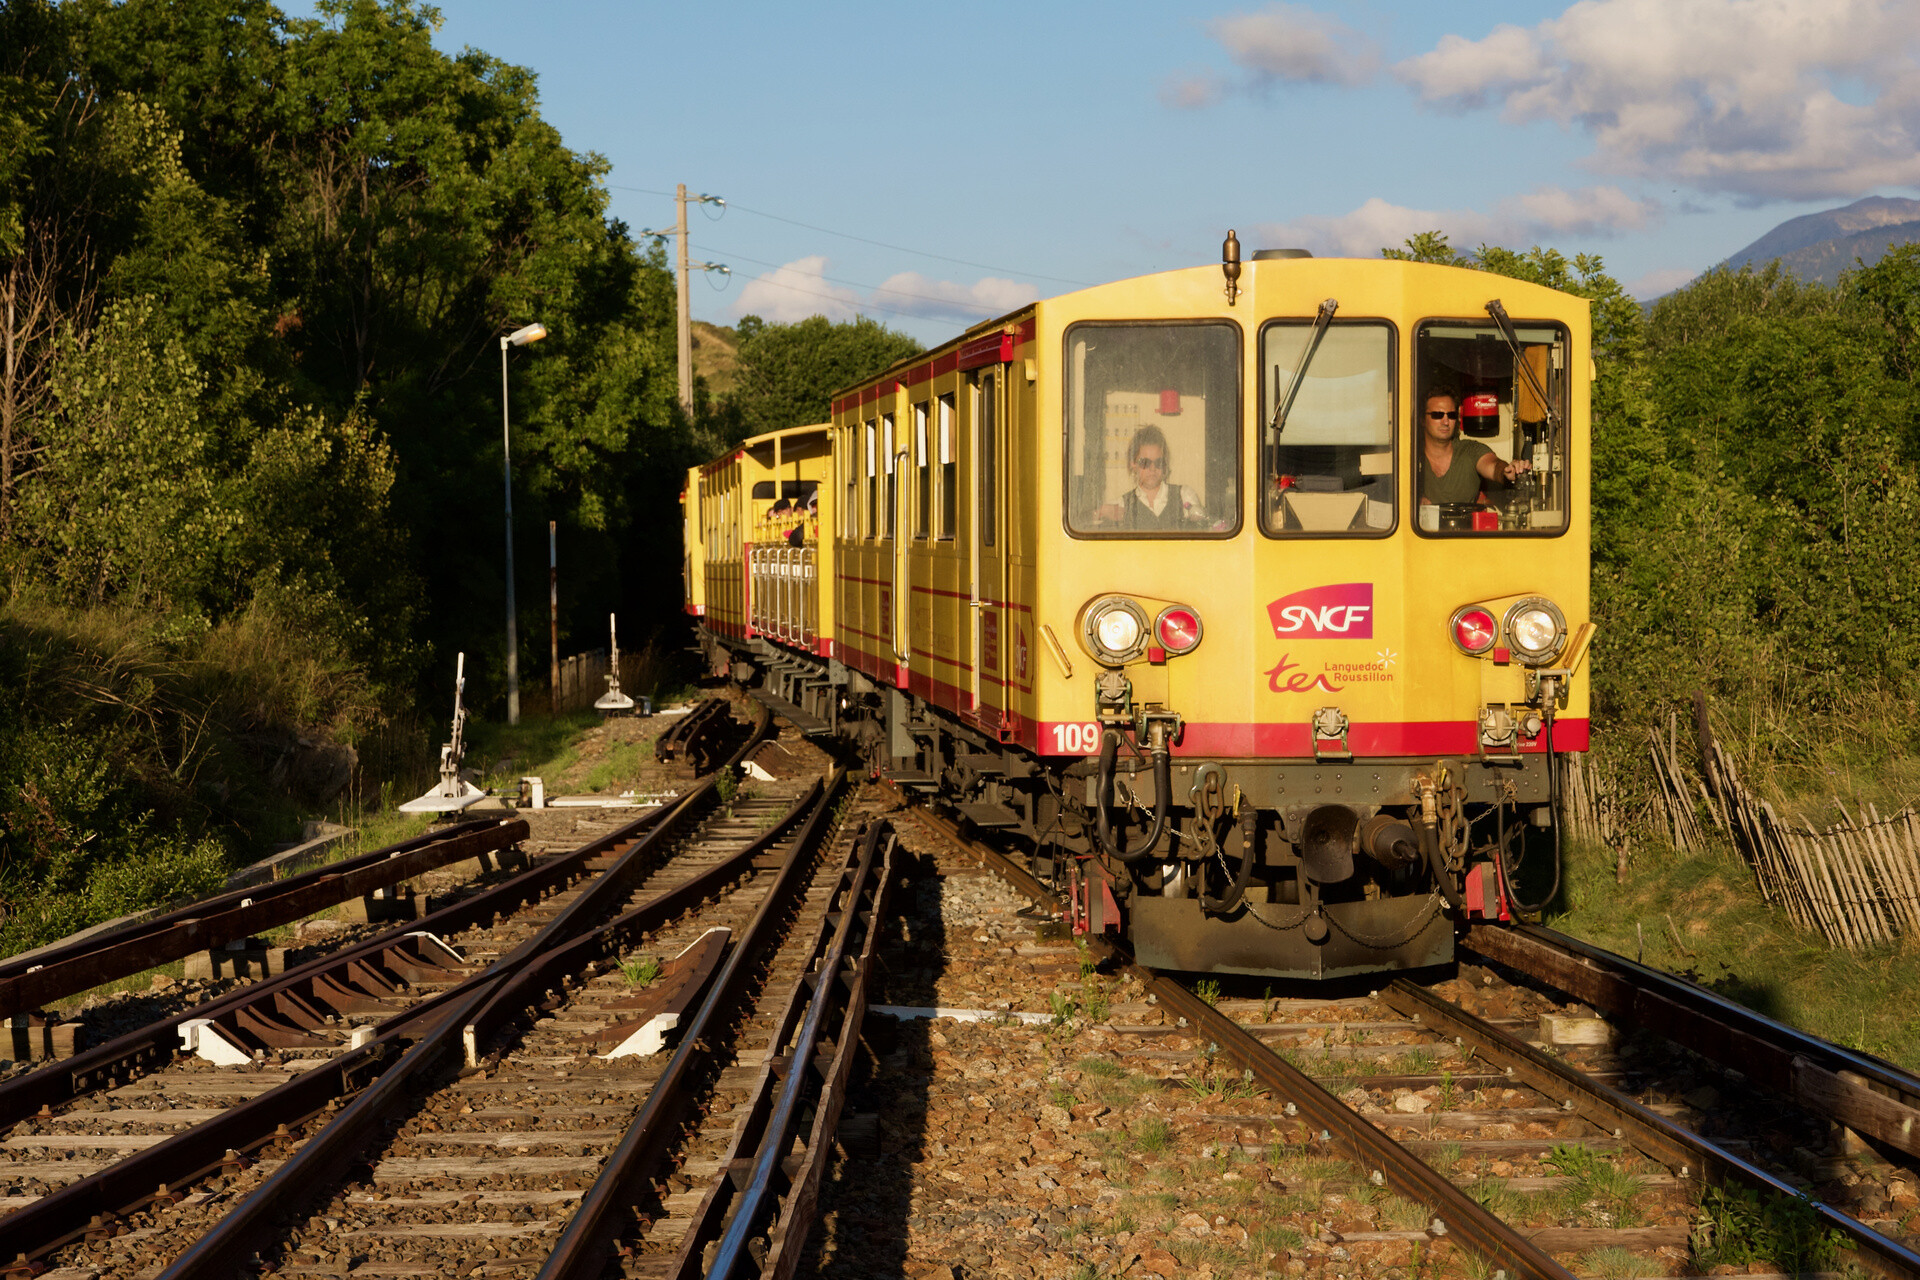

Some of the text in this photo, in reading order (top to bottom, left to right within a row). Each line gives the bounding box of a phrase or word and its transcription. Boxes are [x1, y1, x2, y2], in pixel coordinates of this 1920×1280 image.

[1277, 605, 1370, 632] SNCF
[1263, 653, 1345, 693] ter
[1324, 662, 1384, 673] Languedoc
[1334, 672, 1393, 682] Roussillon
[1053, 723, 1099, 753] 109
